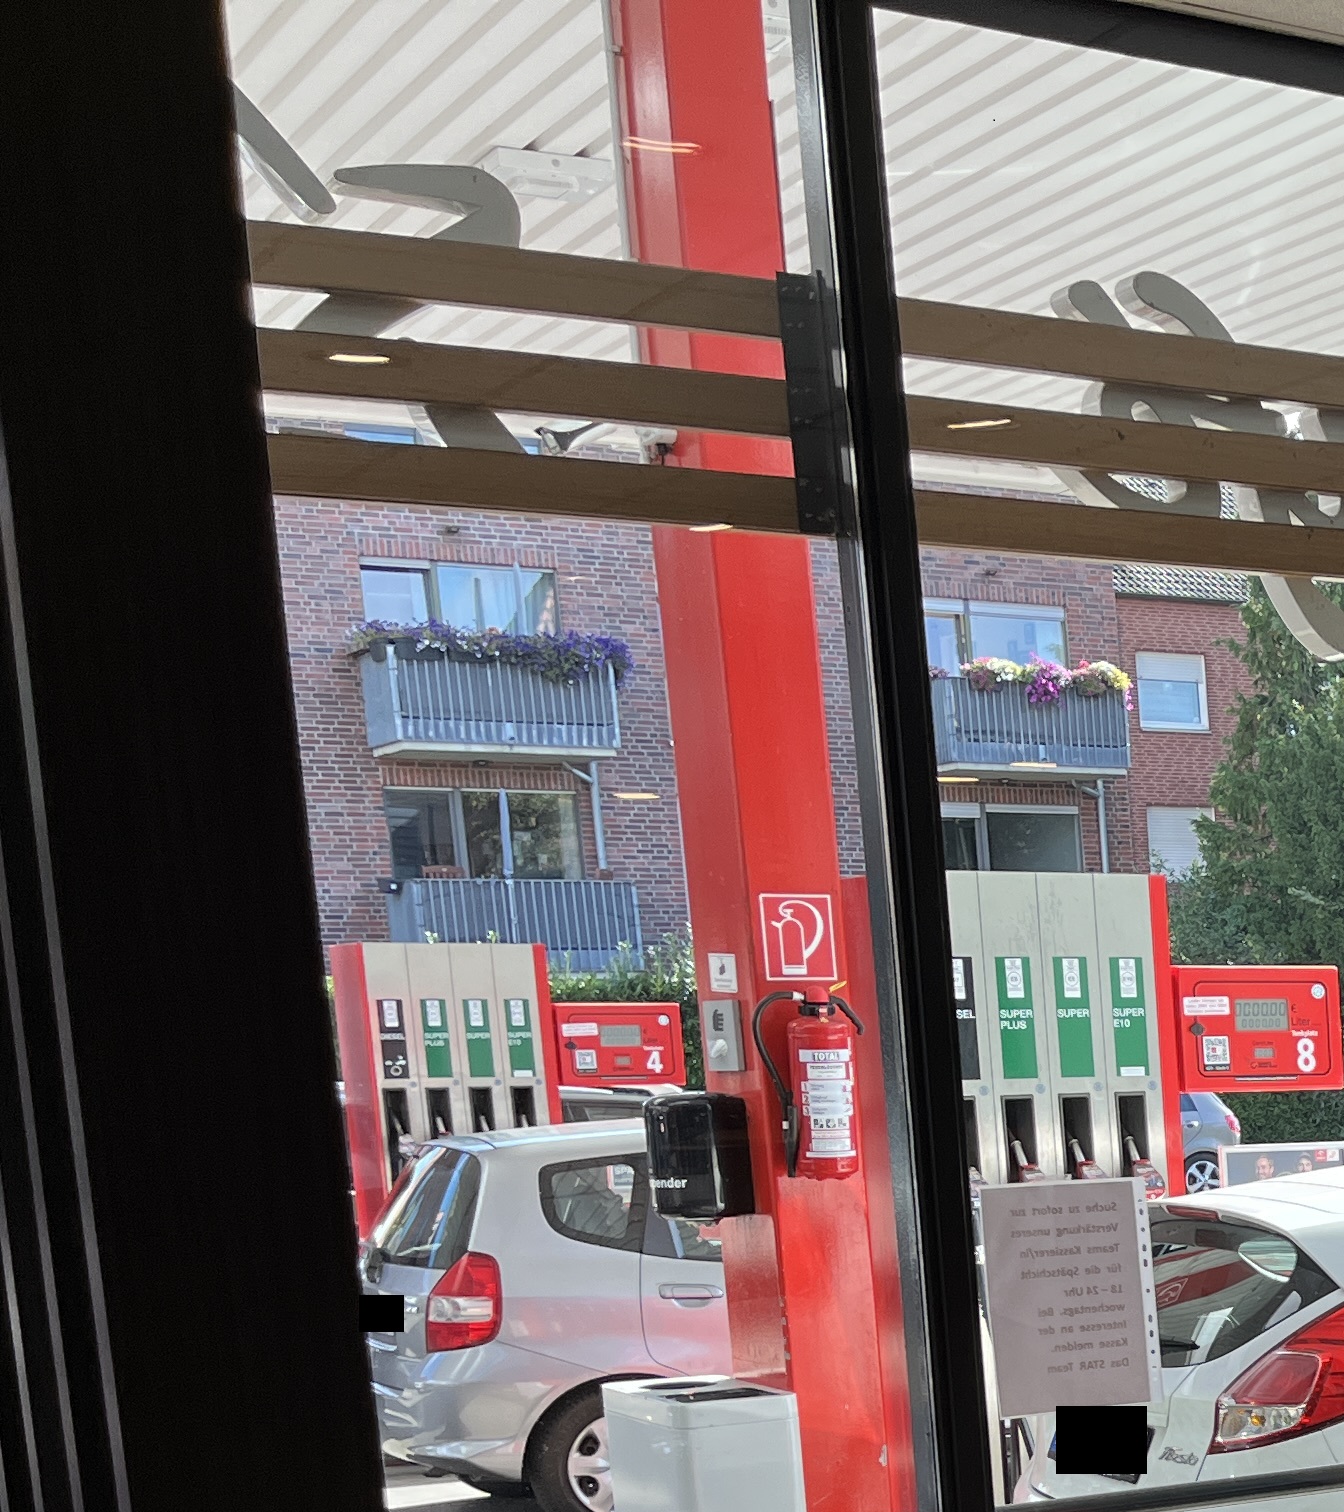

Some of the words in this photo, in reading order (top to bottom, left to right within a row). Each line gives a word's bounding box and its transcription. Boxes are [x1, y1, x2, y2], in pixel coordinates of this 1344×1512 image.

[956, 1009, 976, 1019] SEL
[999, 1008, 1034, 1019] SUPER
[1056, 1008, 1090, 1018] SUPER
[1112, 1008, 1145, 1018] SUPER
[1000, 1020, 1027, 1030] PLUS
[1113, 1018, 1131, 1028] E10
[1291, 1017, 1311, 1027] Liter
[813, 1052, 839, 1061] TOTAL
[1297, 1037, 1317, 1073] 8
[646, 1050, 664, 1074] 4
